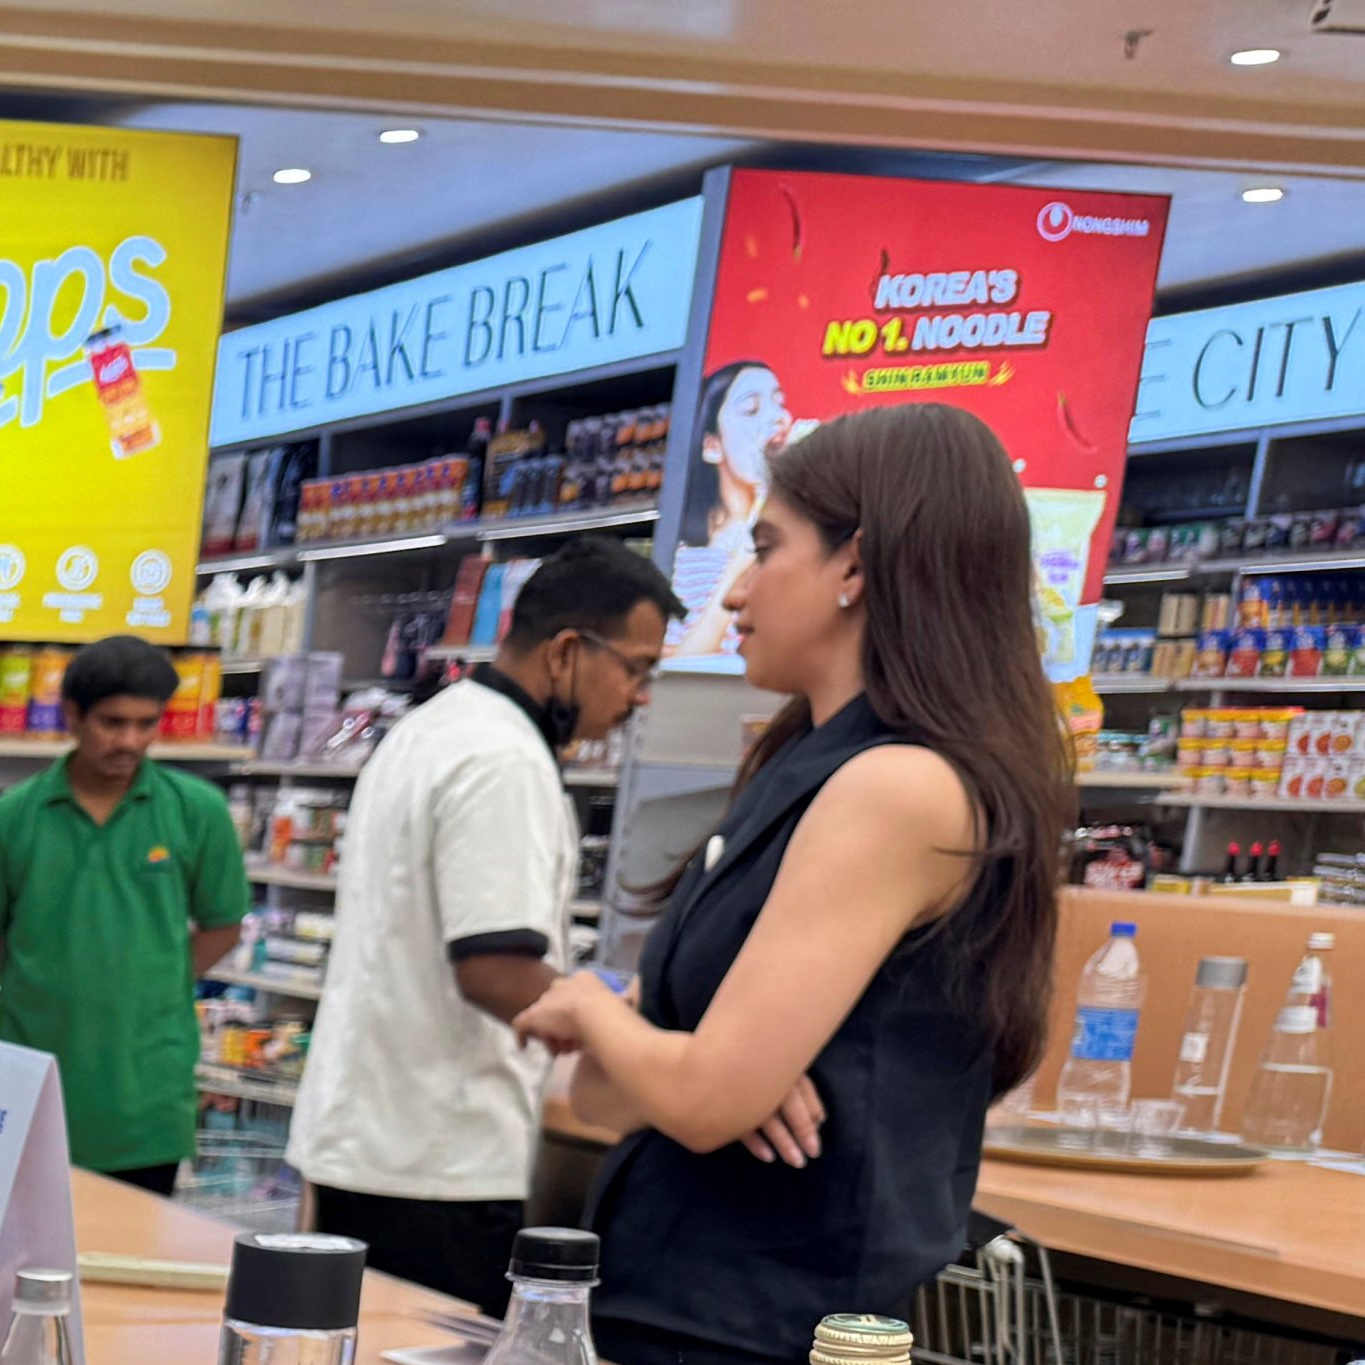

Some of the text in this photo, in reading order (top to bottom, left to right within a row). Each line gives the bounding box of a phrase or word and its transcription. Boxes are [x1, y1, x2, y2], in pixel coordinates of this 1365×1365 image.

[67, 147, 129, 182] WITH
[1072, 214, 1150, 237] NONGSHIM
[875, 269, 1018, 309] KOREA'S
[238, 239, 655, 420] THE BAKE BREAK
[823, 319, 877, 355] NO
[911, 310, 1051, 351] NOODLE
[1192, 305, 1365, 413] CITY
